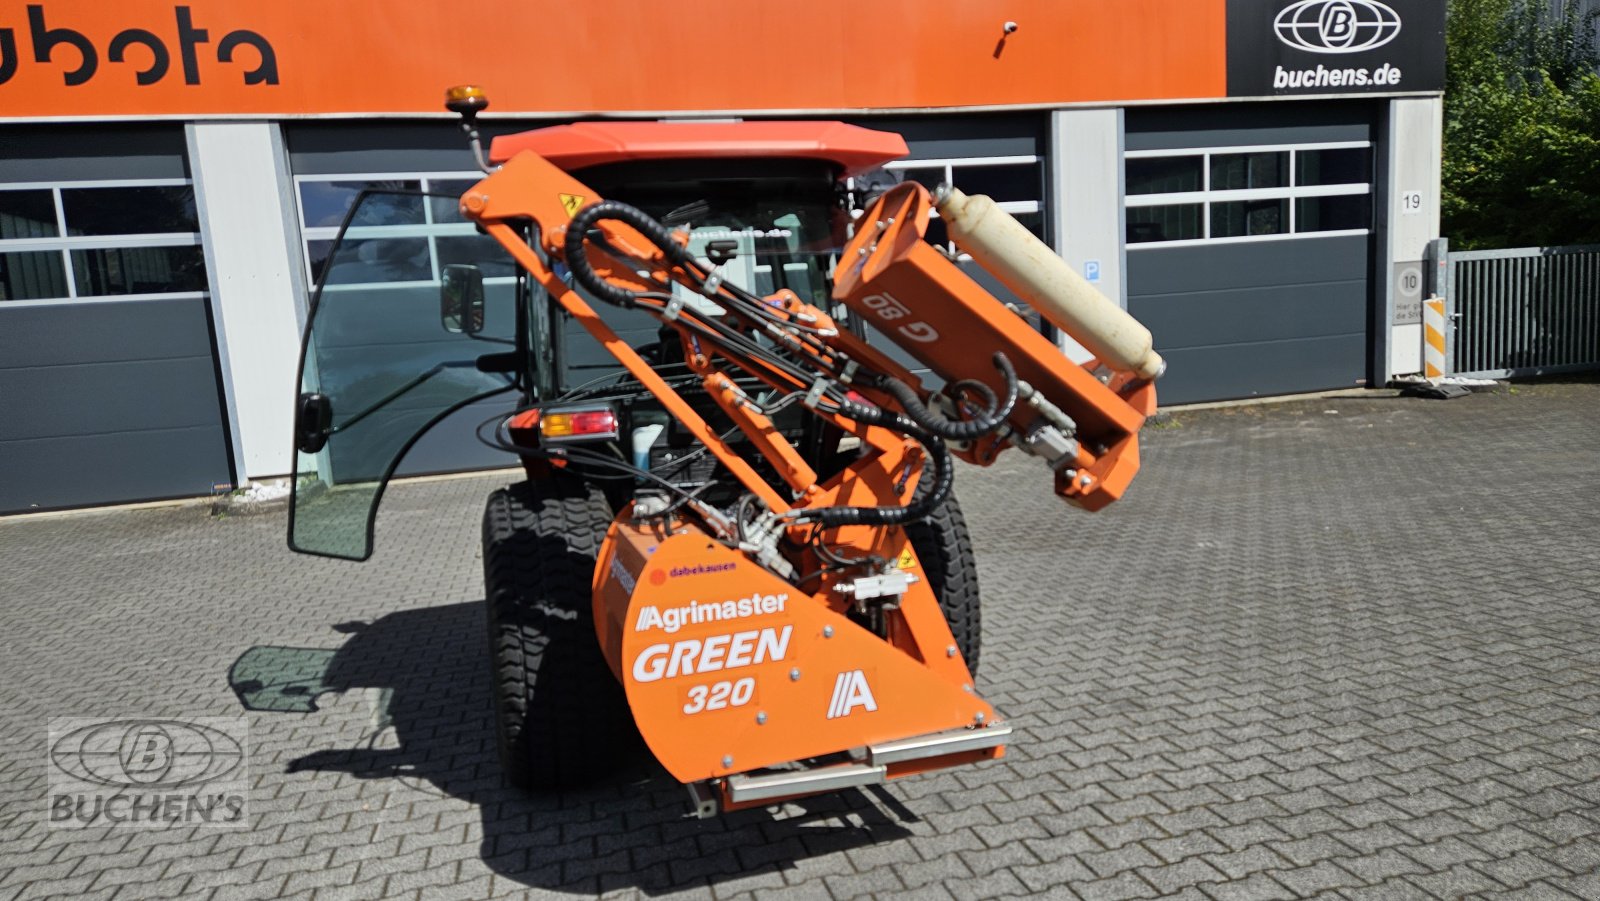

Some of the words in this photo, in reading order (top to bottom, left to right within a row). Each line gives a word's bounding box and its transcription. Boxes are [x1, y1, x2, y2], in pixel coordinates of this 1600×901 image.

[1273, 62, 1401, 88] buchens.de
[1403, 194, 1420, 209] 19
[1404, 275, 1417, 289] 10
[862, 294, 904, 320] 80
[898, 321, 939, 343] G
[635, 593, 788, 633] Agrimaster
[632, 625, 793, 682] GREEN
[683, 677, 755, 715] 320
